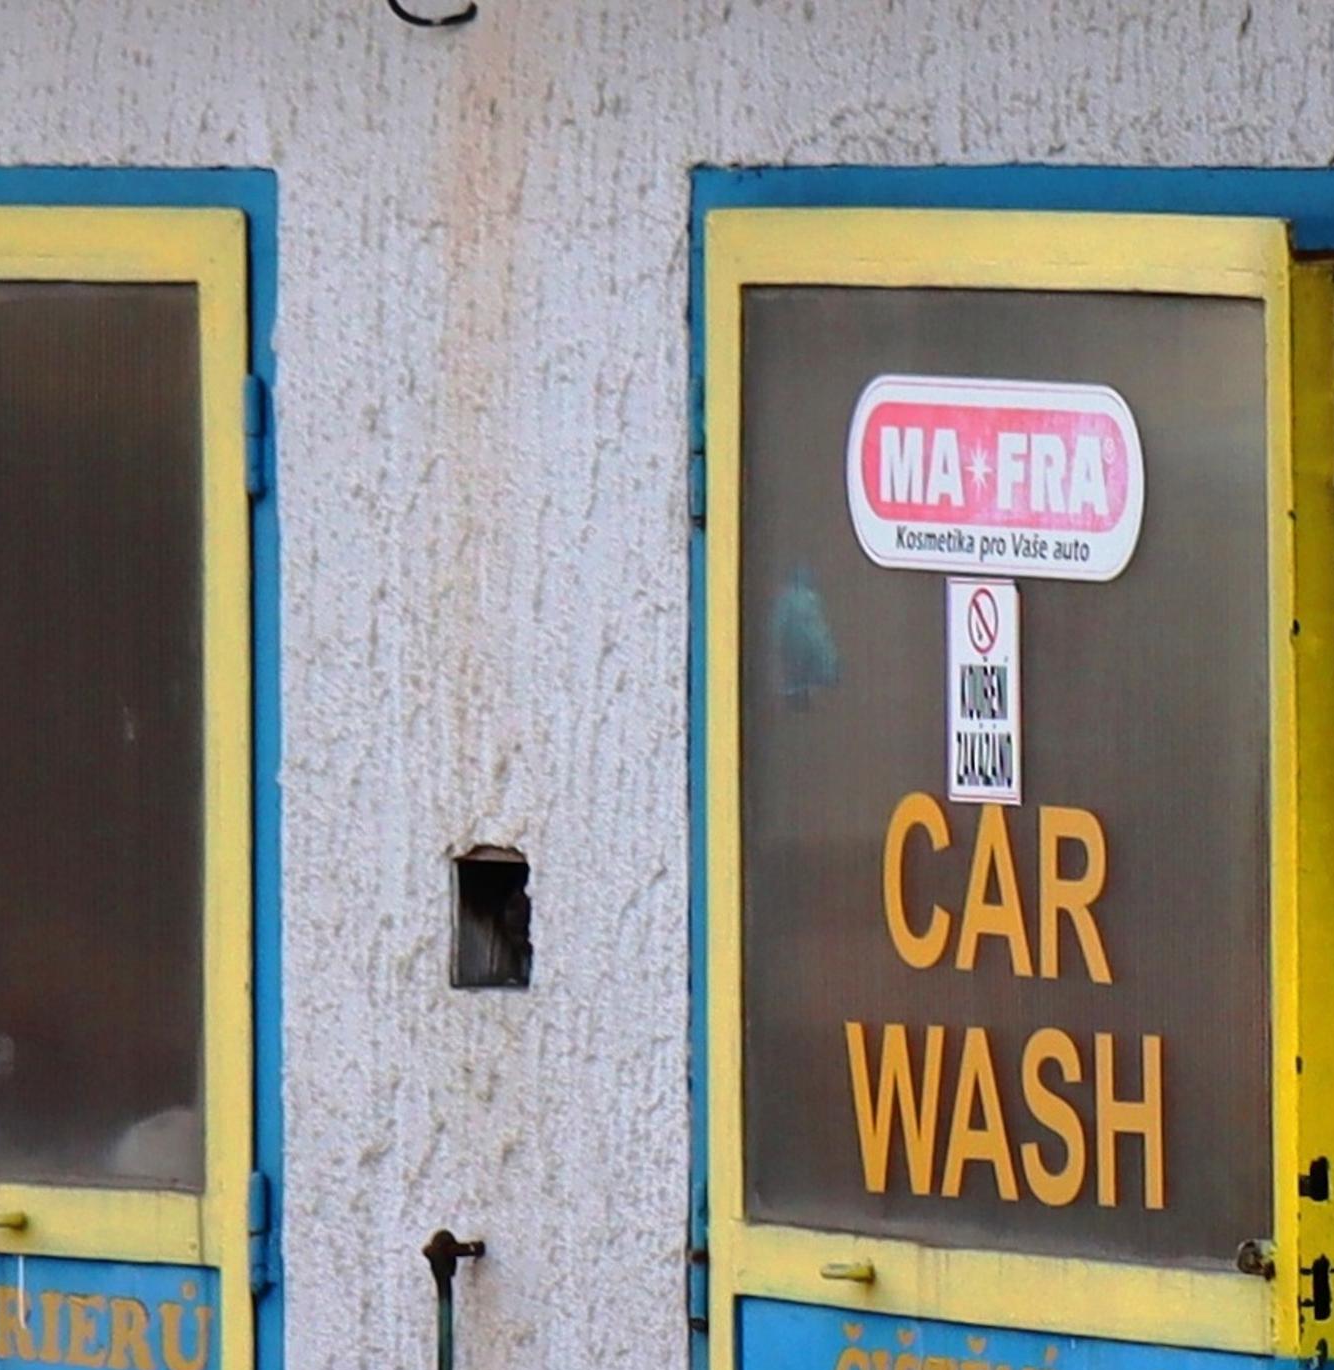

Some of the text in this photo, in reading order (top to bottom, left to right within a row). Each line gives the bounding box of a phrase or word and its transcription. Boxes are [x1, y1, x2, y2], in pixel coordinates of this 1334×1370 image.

[896, 525, 1090, 562] Kosmetika pro Vaše auto
[883, 791, 1113, 985] CAR
[845, 1021, 1164, 1210] WASH
